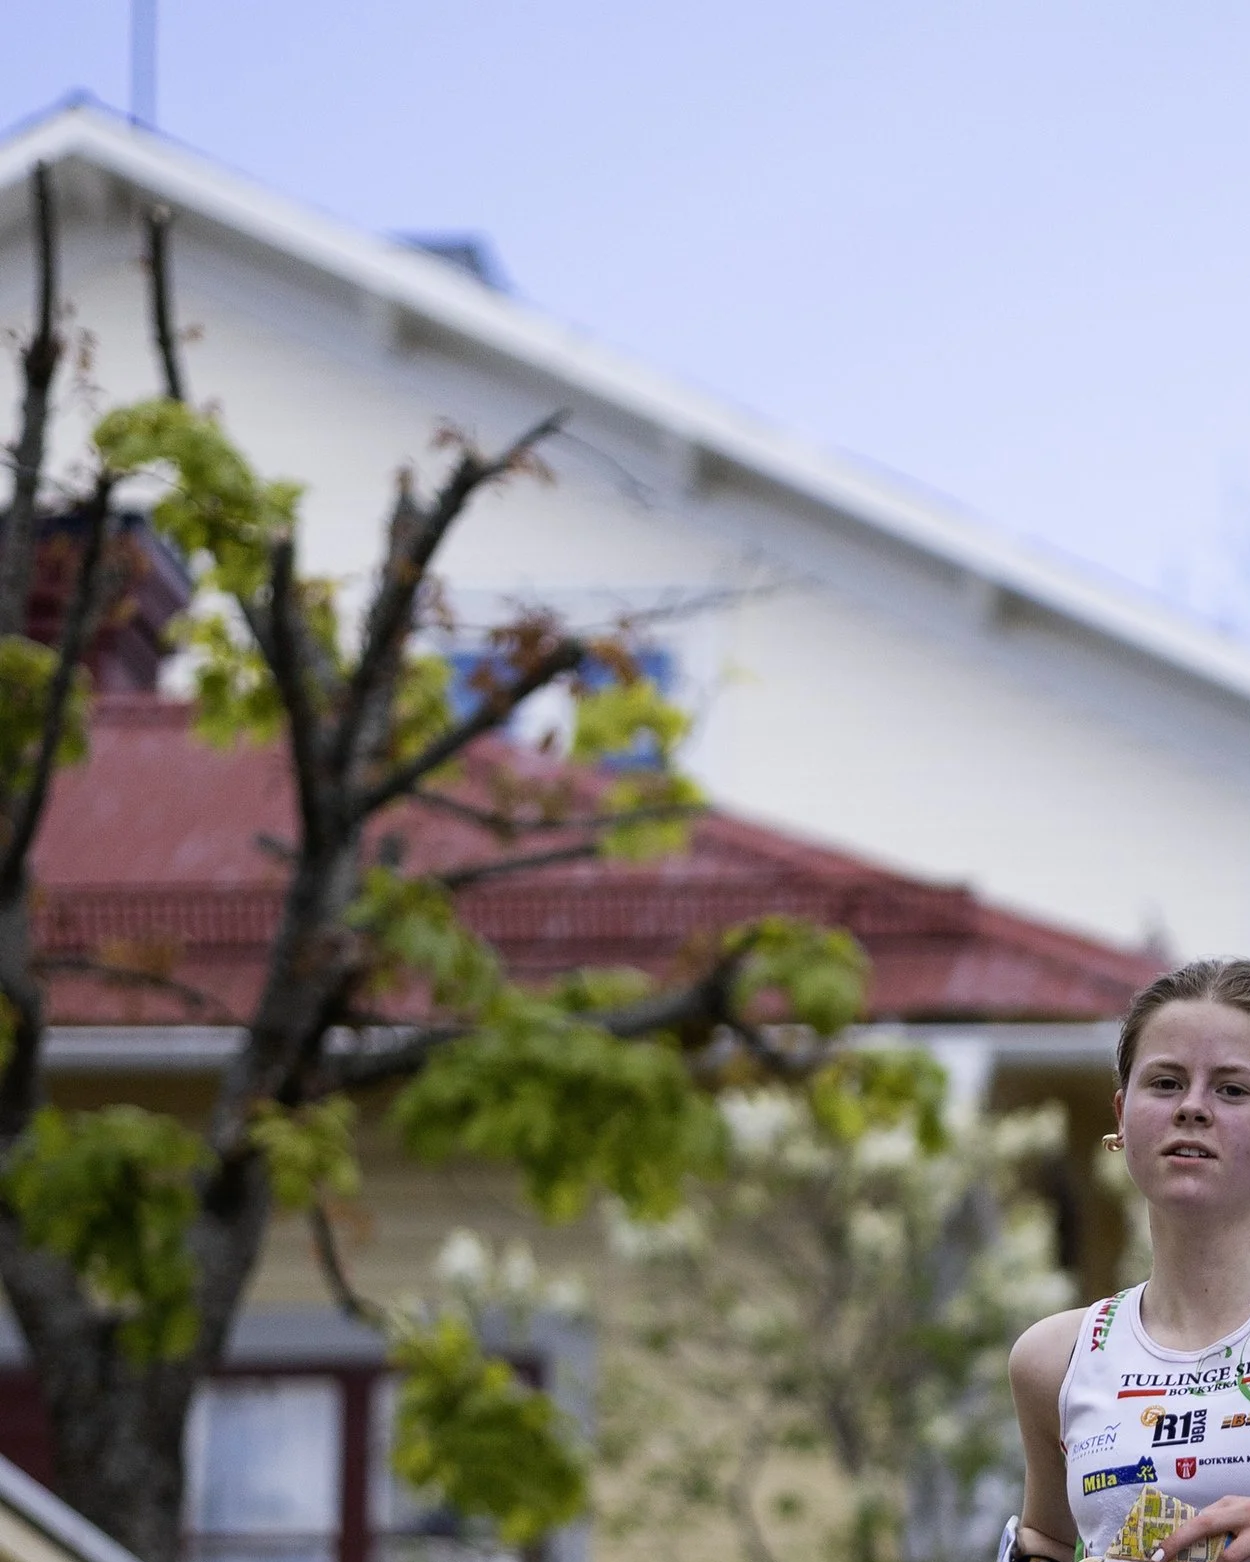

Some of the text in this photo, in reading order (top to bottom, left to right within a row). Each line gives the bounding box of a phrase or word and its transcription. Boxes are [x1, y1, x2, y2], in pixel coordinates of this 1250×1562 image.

[1121, 1366, 1231, 1387] TULLINGE
[1168, 1380, 1238, 1397] BOTKYRKA
[1153, 1411, 1193, 1442] R1
[1190, 1408, 1207, 1444] BYGG
[1199, 1456, 1245, 1466] BOTKYRKA
[1083, 1472, 1118, 1494] Mila
